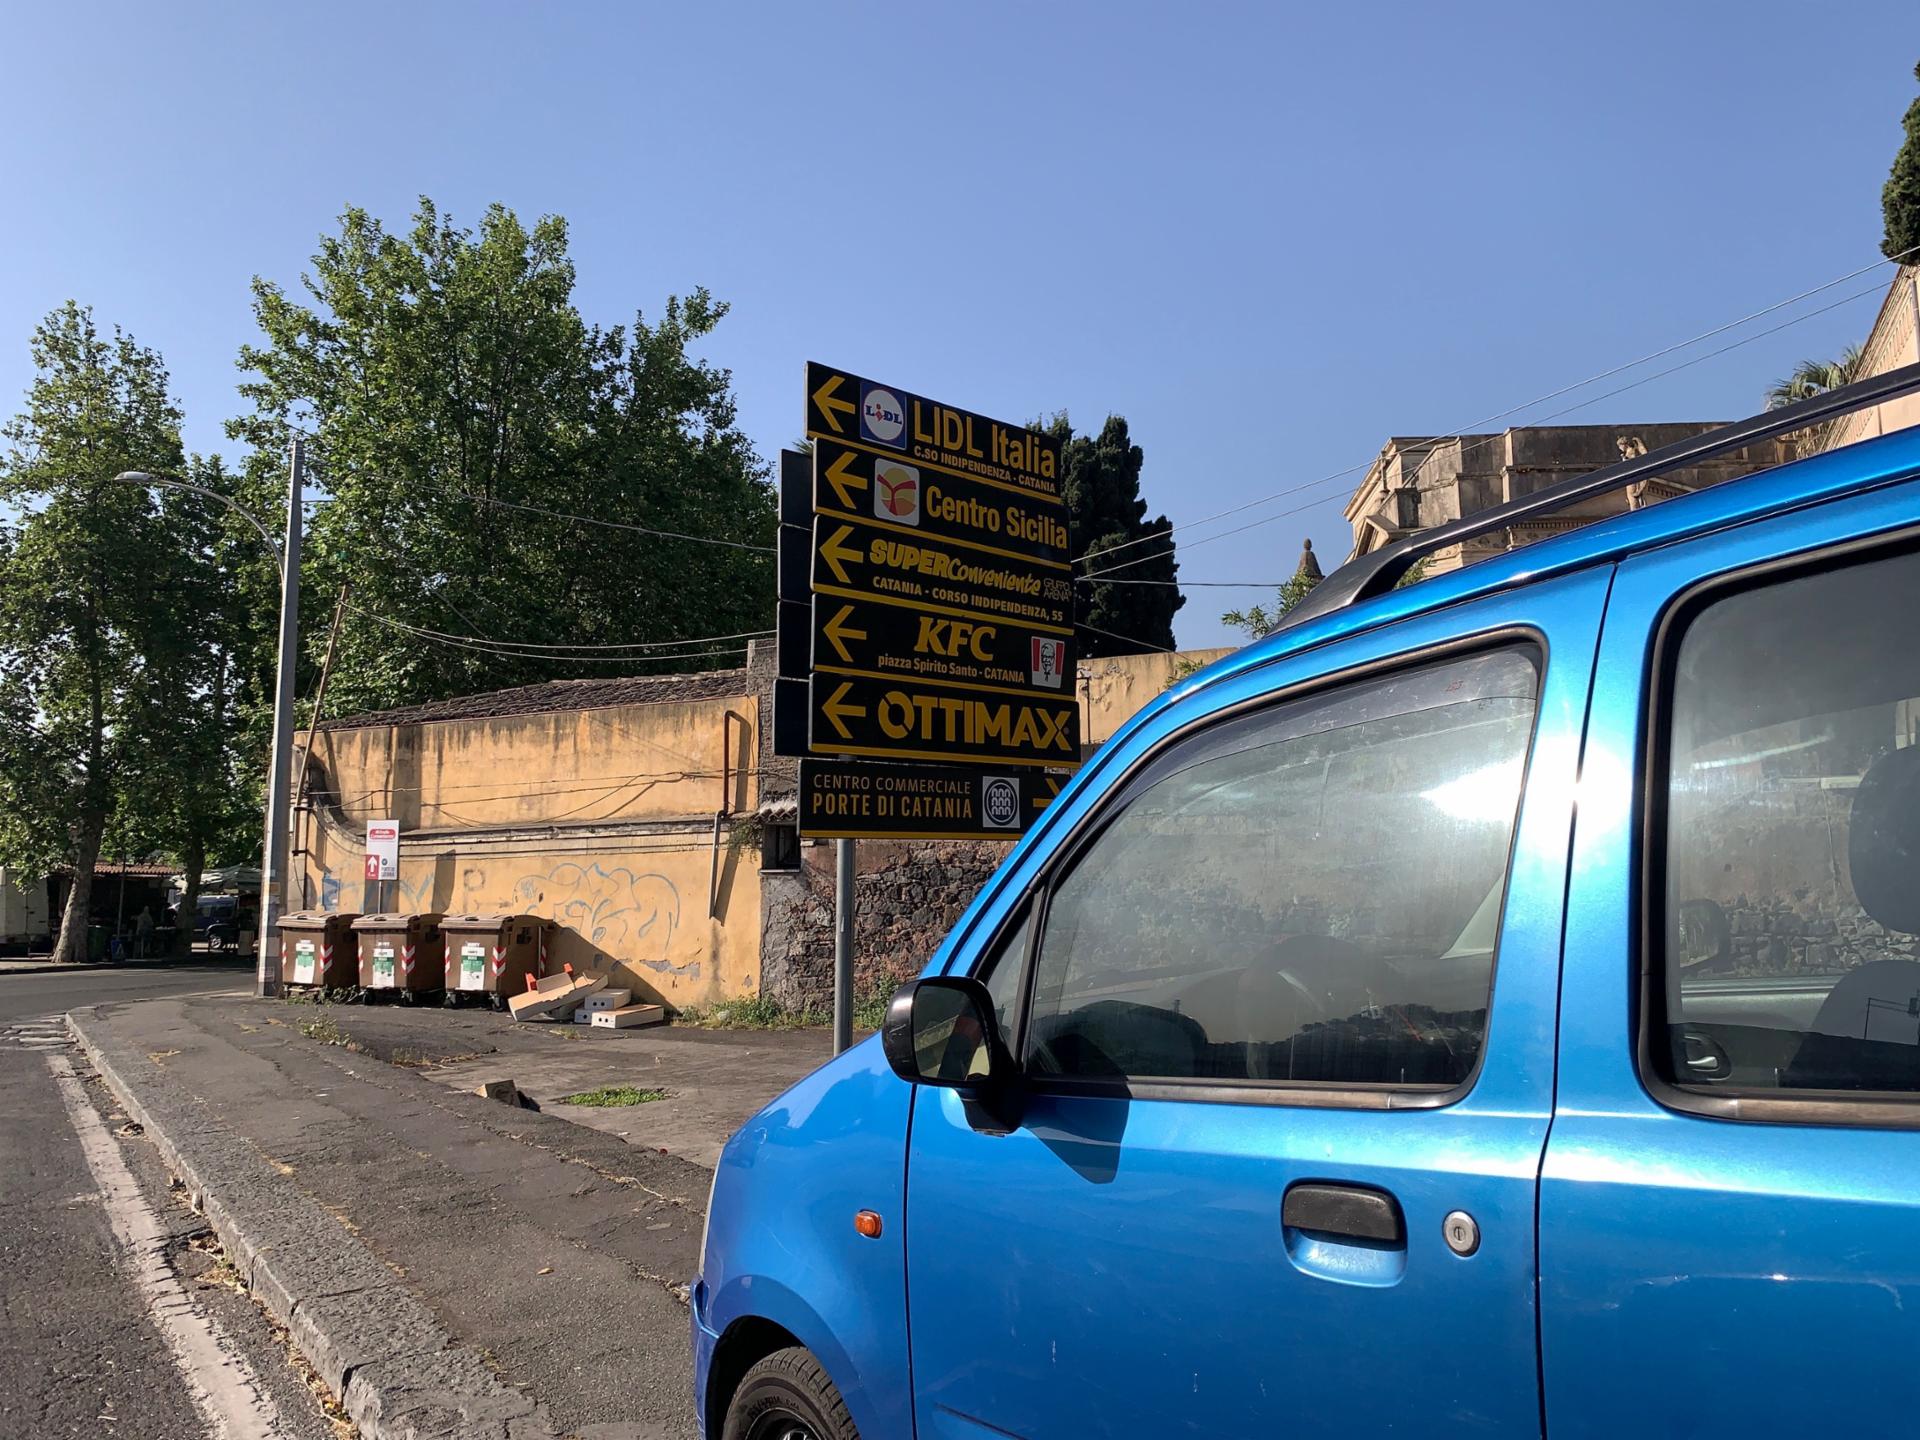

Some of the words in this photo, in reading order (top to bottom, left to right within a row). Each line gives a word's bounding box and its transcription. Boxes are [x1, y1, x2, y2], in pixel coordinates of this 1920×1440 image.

[914, 400, 984, 458] LIDL
[991, 423, 1056, 479] Italia
[914, 445, 938, 462] C.SO
[941, 452, 1012, 481] INDIPENDENZA
[1018, 474, 1056, 494] CATANIA
[926, 485, 1000, 532] Centro
[1006, 506, 1068, 550] Sicilia
[872, 575, 922, 596] CATANIA
[932, 587, 968, 605] CORSO
[971, 595, 1050, 621] INDIPENDENZA,
[913, 616, 997, 662] KFC
[877, 652, 912, 670] piazza
[913, 657, 948, 675] Spirito
[949, 662, 977, 678] Santo
[984, 666, 1025, 684] CATANIA
[877, 690, 1073, 752] OTTIMAX
[812, 792, 870, 816] PORTE
[877, 795, 894, 816] DI
[900, 797, 973, 819] CATANIA
[813, 774, 870, 790] CENTRO
[875, 777, 971, 794] COMMERCIALE
